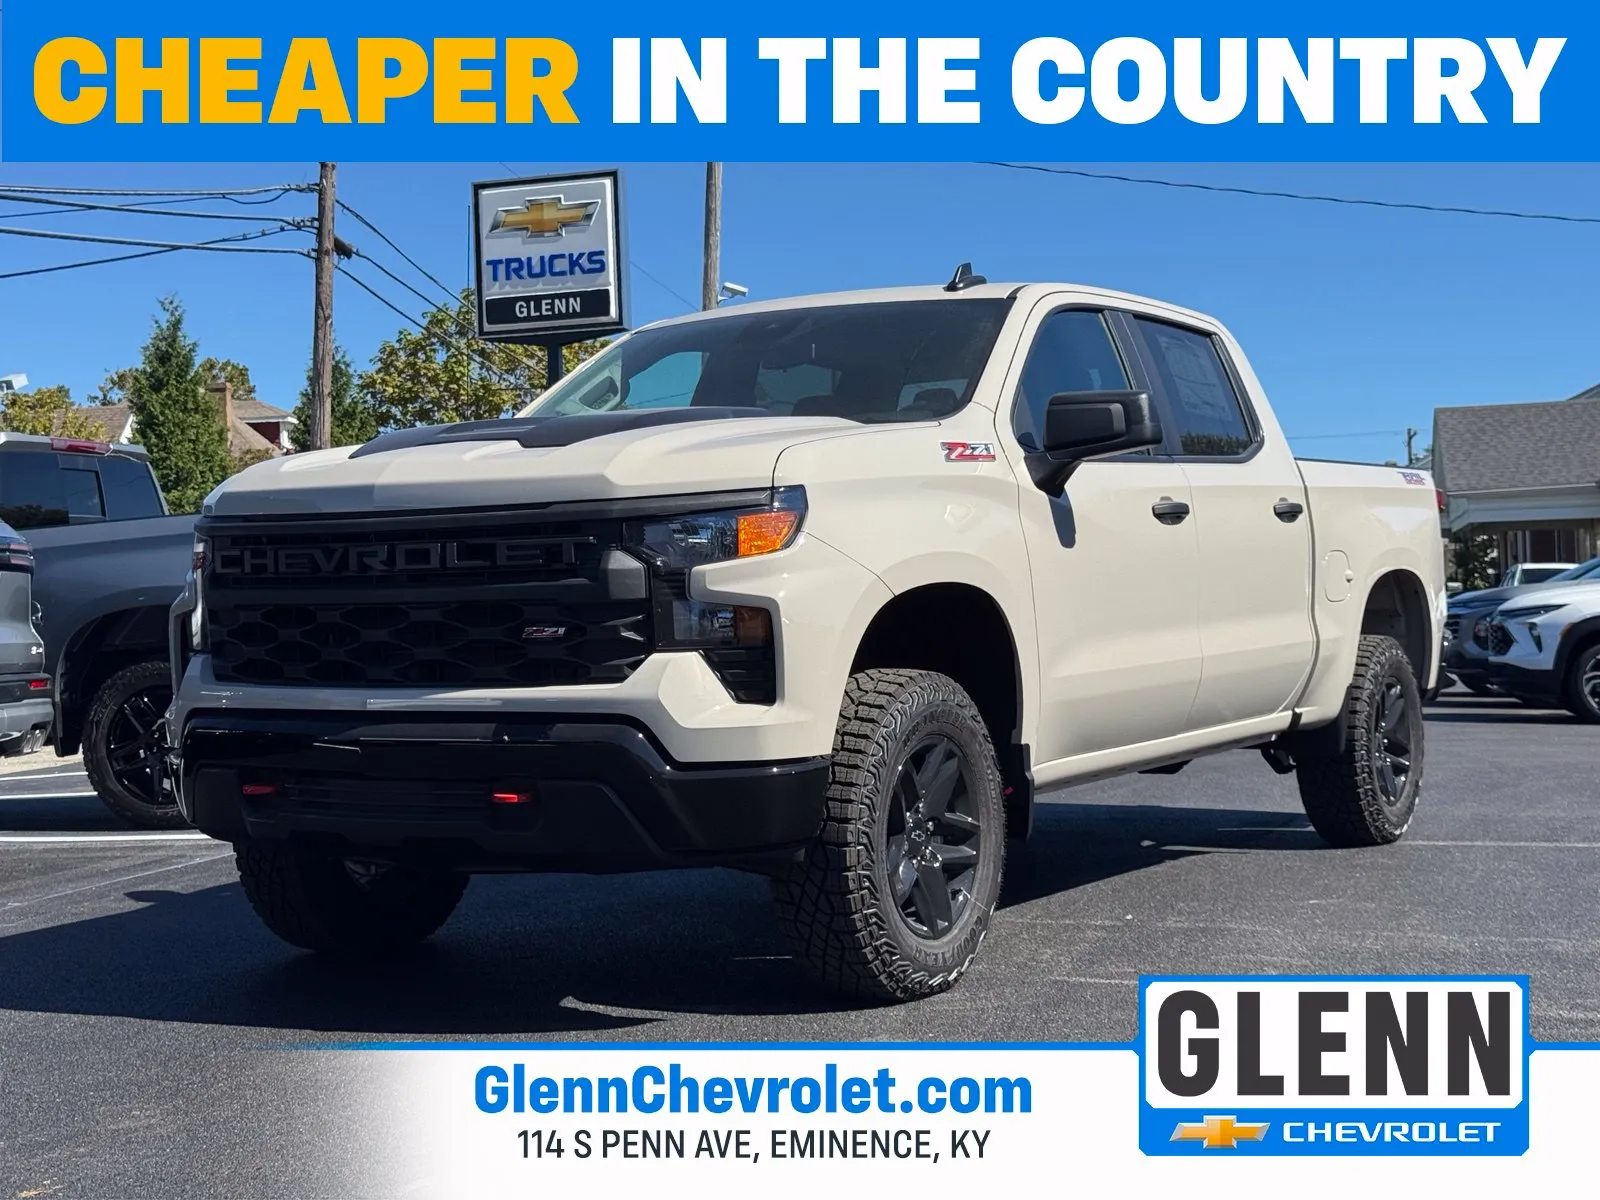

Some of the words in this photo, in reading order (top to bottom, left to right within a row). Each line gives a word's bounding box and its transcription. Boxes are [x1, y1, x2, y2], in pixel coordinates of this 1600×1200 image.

[486, 250, 606, 282] TRUCKS
[515, 297, 581, 317] GLENN
[940, 441, 996, 462] Z71
[214, 537, 597, 574] CHEVROLET
